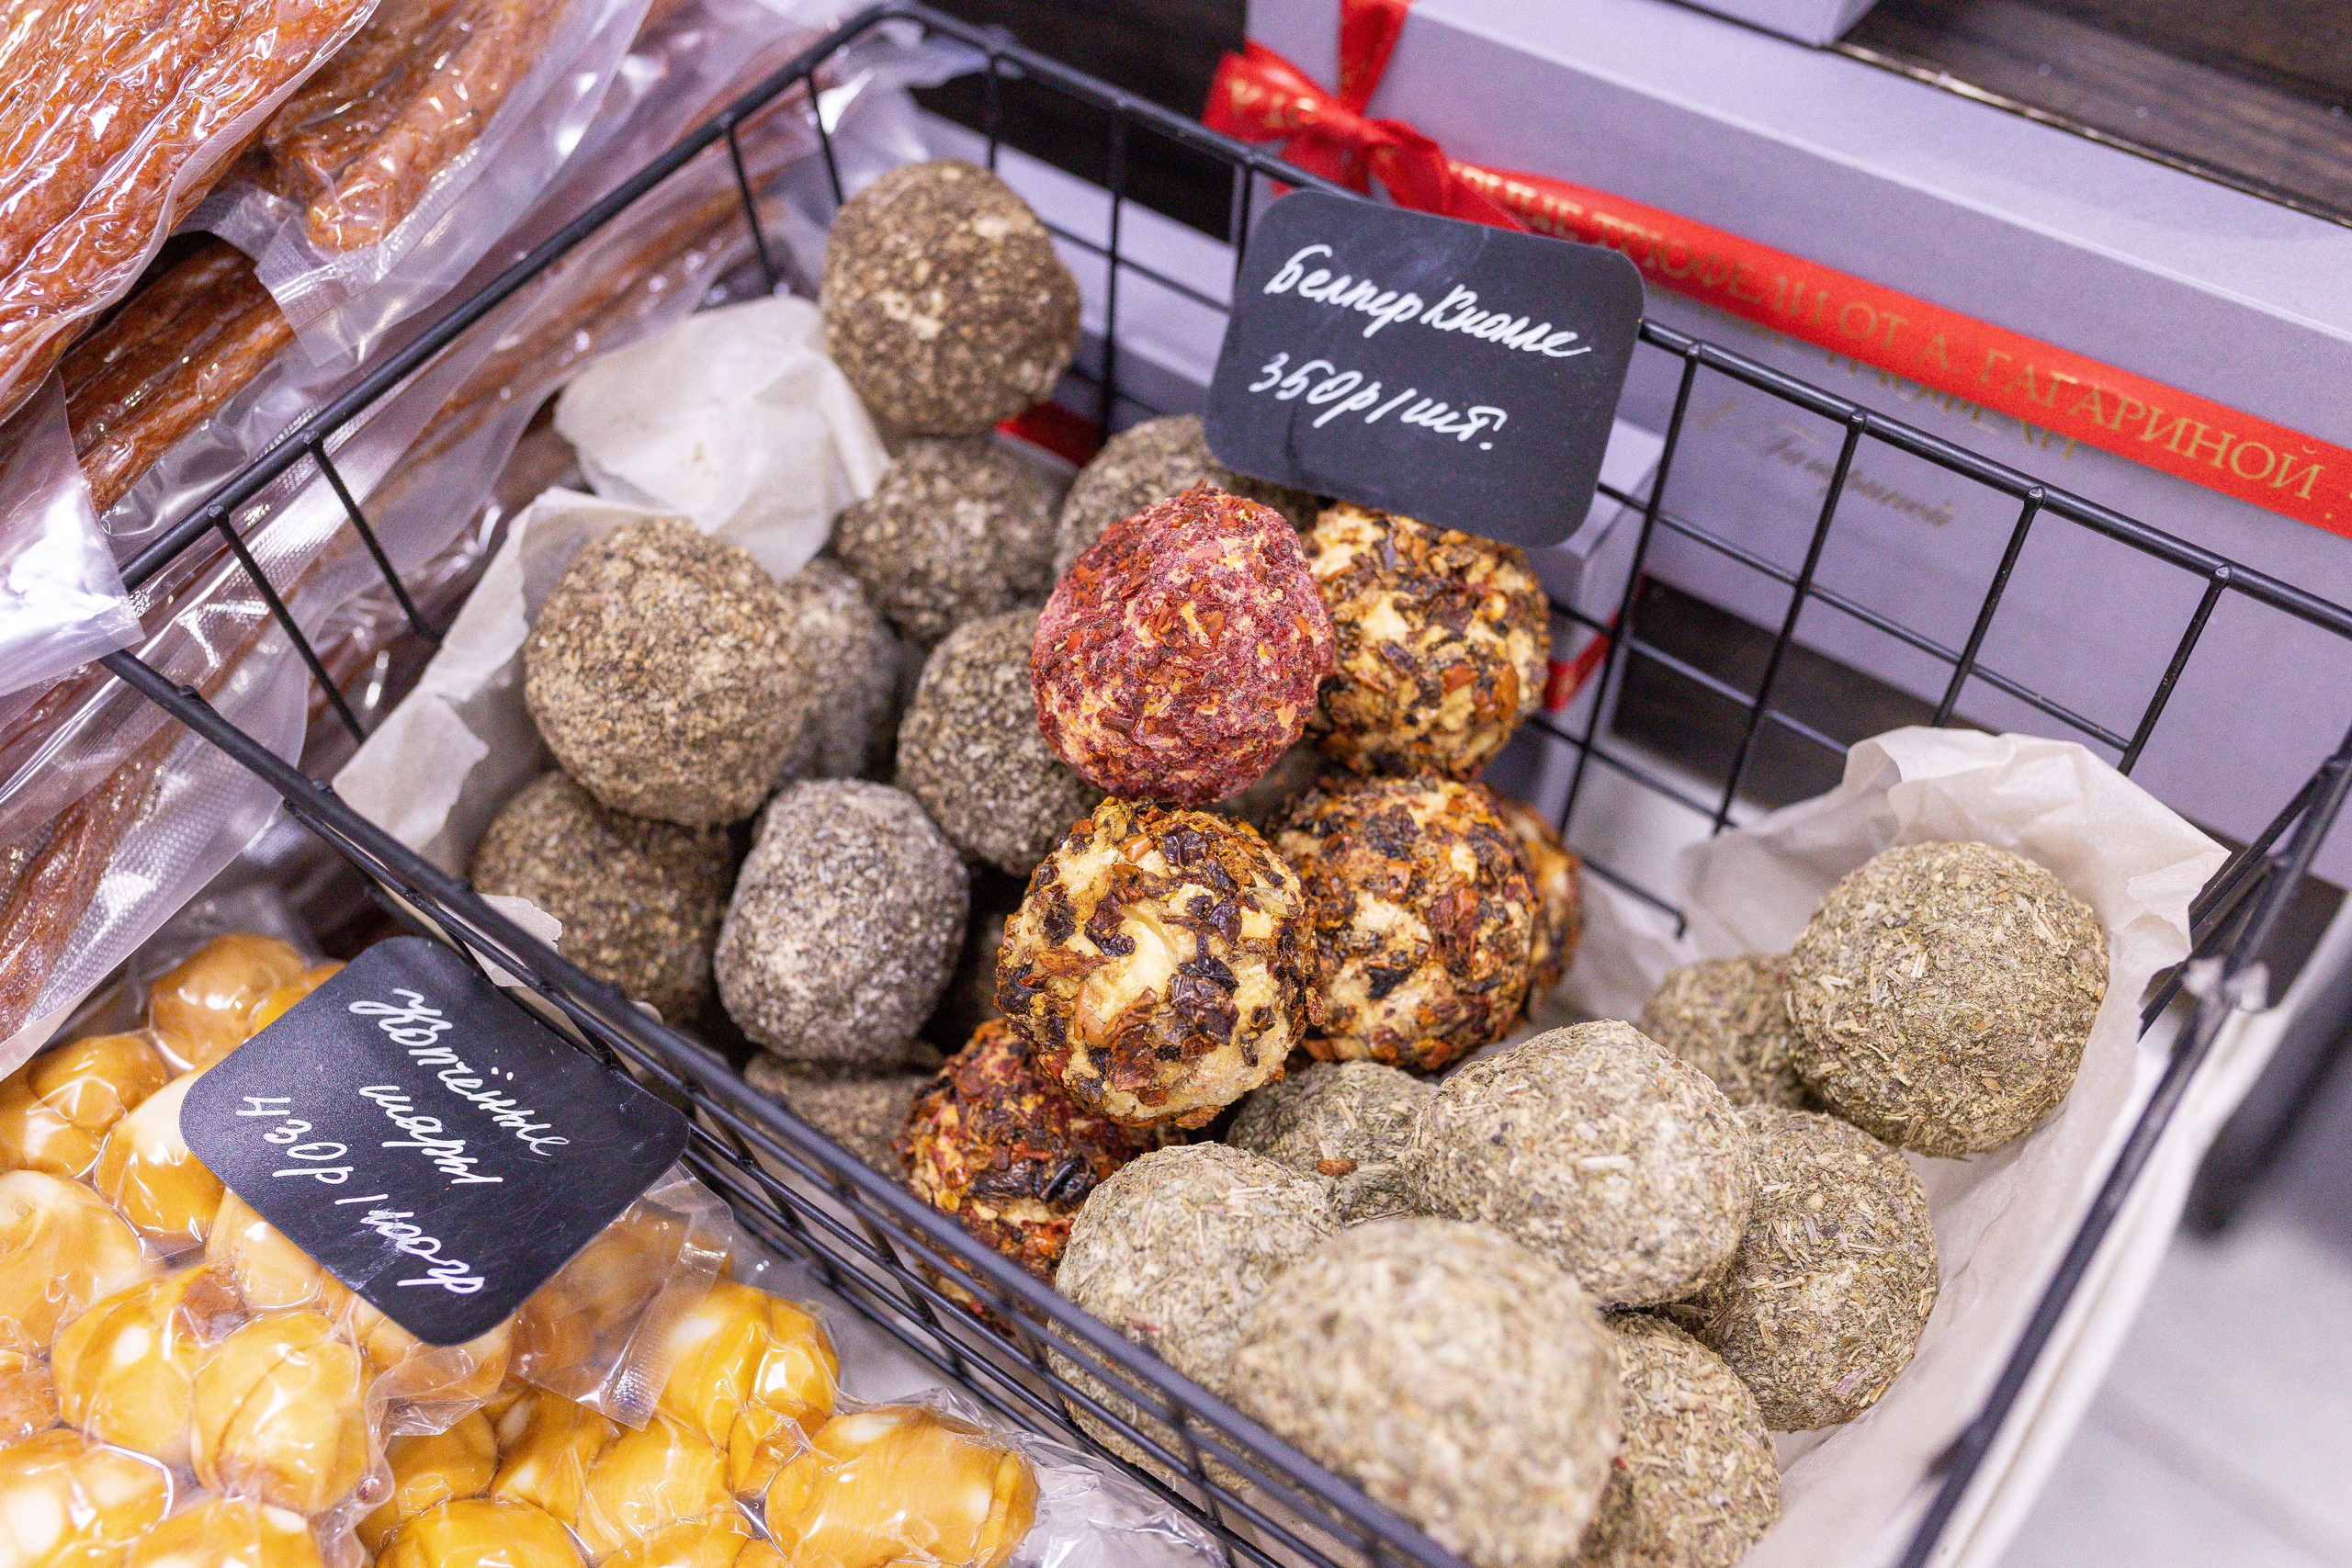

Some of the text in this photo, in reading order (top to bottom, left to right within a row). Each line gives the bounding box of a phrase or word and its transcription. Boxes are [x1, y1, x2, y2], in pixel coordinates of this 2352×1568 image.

[1264, 243, 1423, 338] Белпер
[1838, 300, 1908, 349] ОТ
[1978, 348, 2326, 501] ГАГАРИНОЙ
